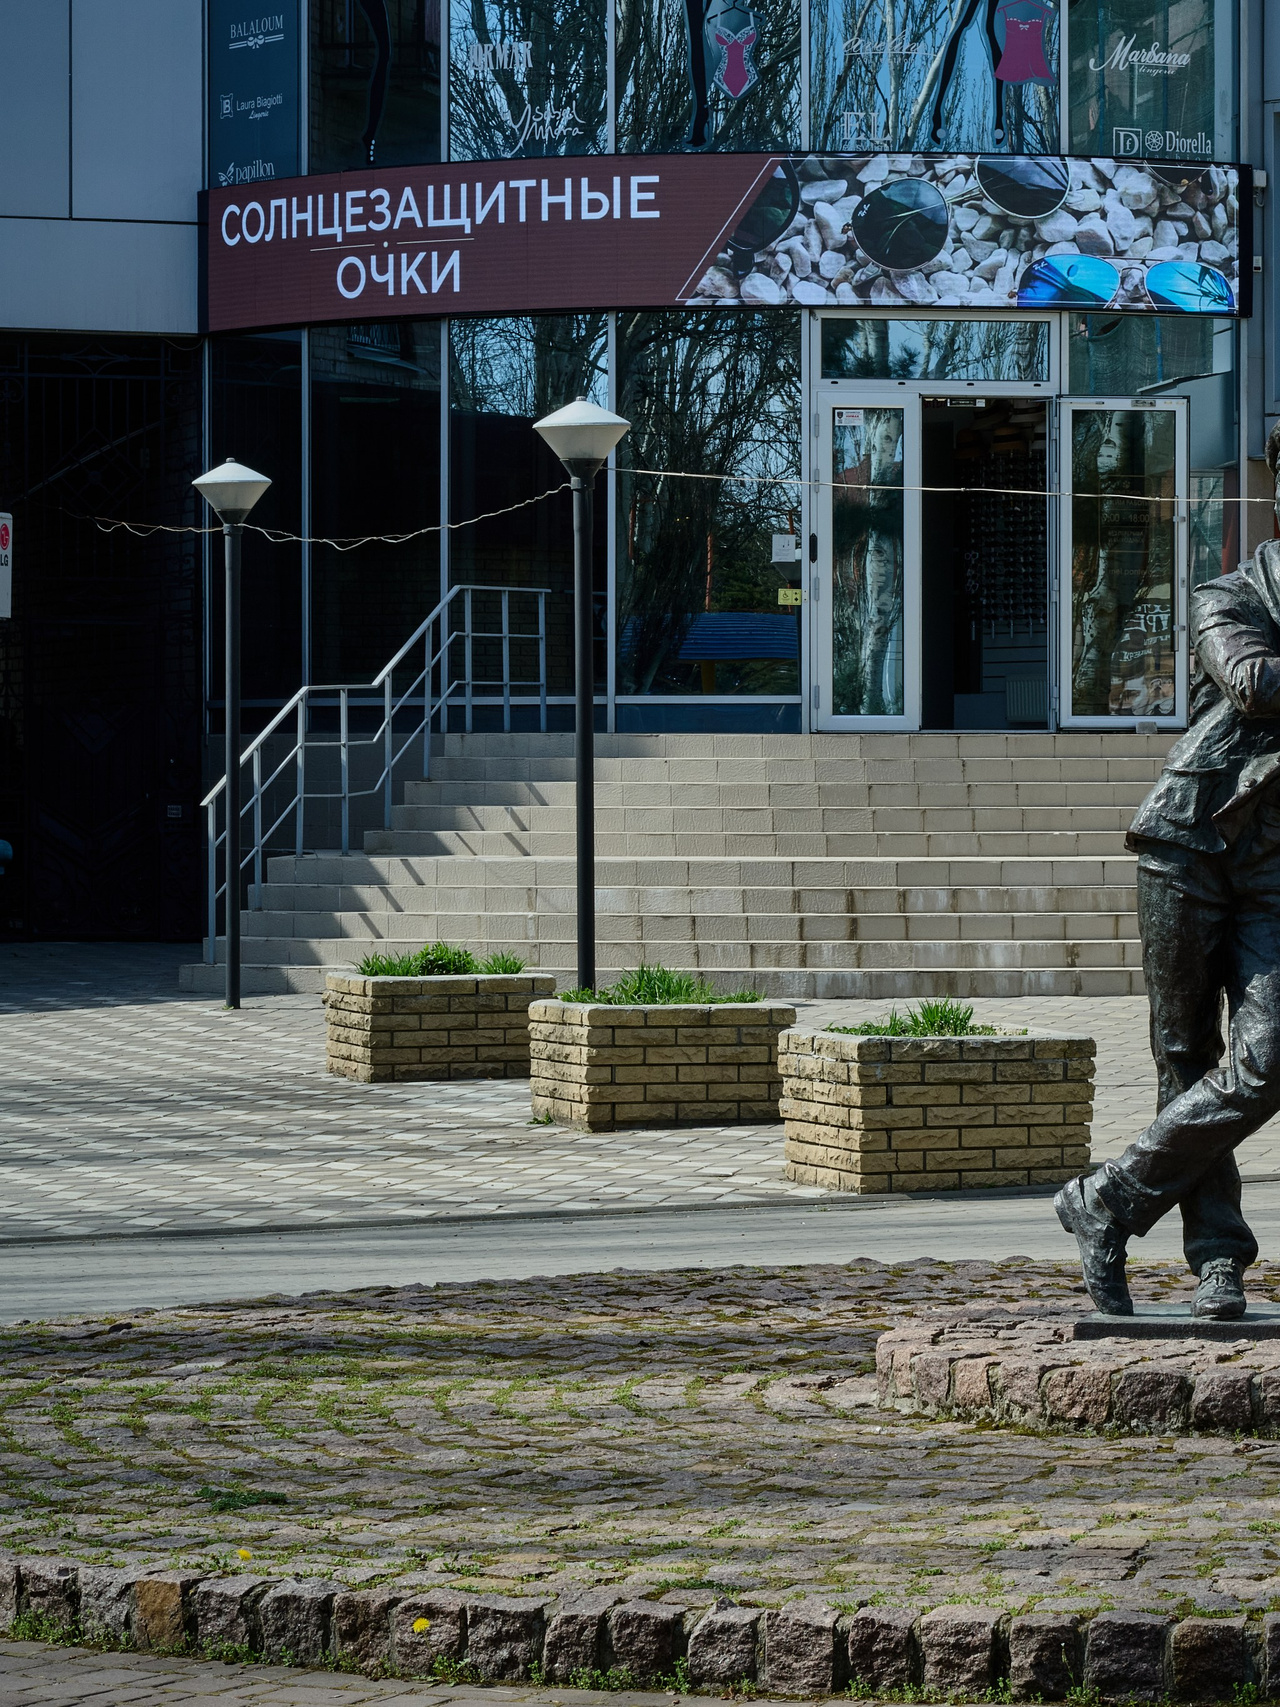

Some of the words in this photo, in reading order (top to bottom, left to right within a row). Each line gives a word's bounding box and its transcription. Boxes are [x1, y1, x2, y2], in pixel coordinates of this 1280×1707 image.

[229, 14, 284, 39] BALALOUM
[236, 99, 256, 111] Laura
[256, 93, 284, 109] Biagiotti
[1165, 130, 1213, 155] Diorella
[235, 159, 276, 185] papillon
[221, 174, 661, 247] СОЛНЦЕЗАЩИТНЫЕ
[336, 249, 461, 300] ОЧКИ
